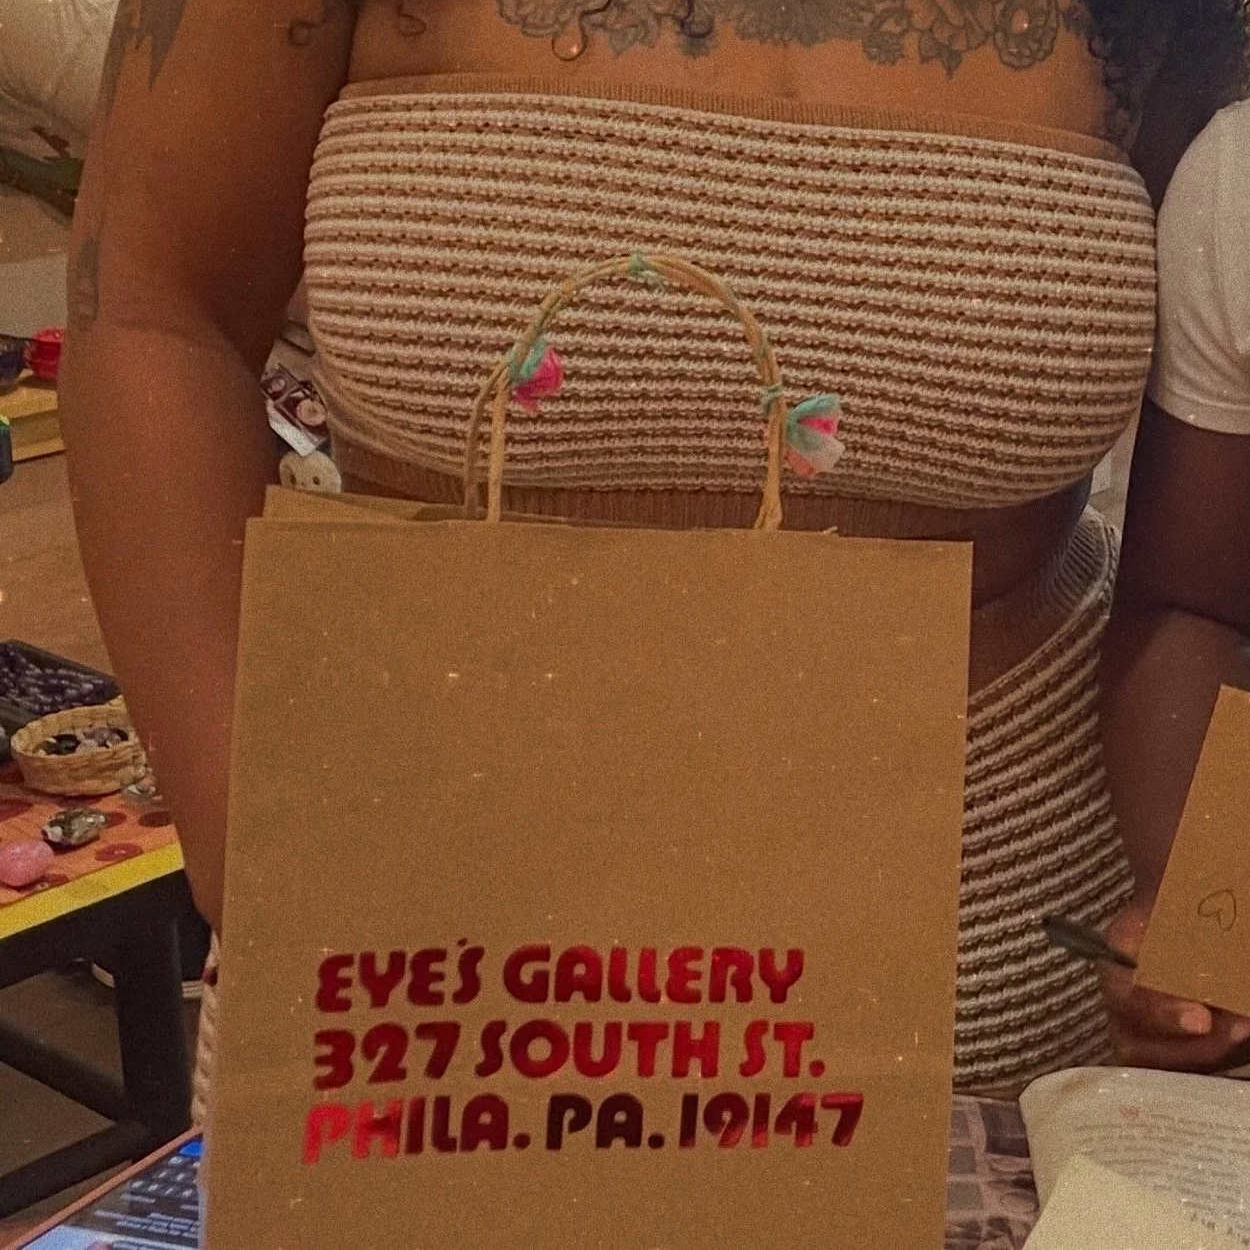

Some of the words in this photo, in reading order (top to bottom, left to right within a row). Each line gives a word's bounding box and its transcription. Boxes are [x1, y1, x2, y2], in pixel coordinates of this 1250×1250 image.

[315, 939, 484, 1012] EYE'S
[502, 945, 805, 1005] GALLERY
[314, 1021, 461, 1091] 327
[475, 1019, 721, 1079] SOUTH
[738, 1020, 826, 1079] ST.
[304, 1093, 531, 1164] PHILA.
[545, 1093, 666, 1151] PA.
[678, 1092, 864, 1149] 19147
